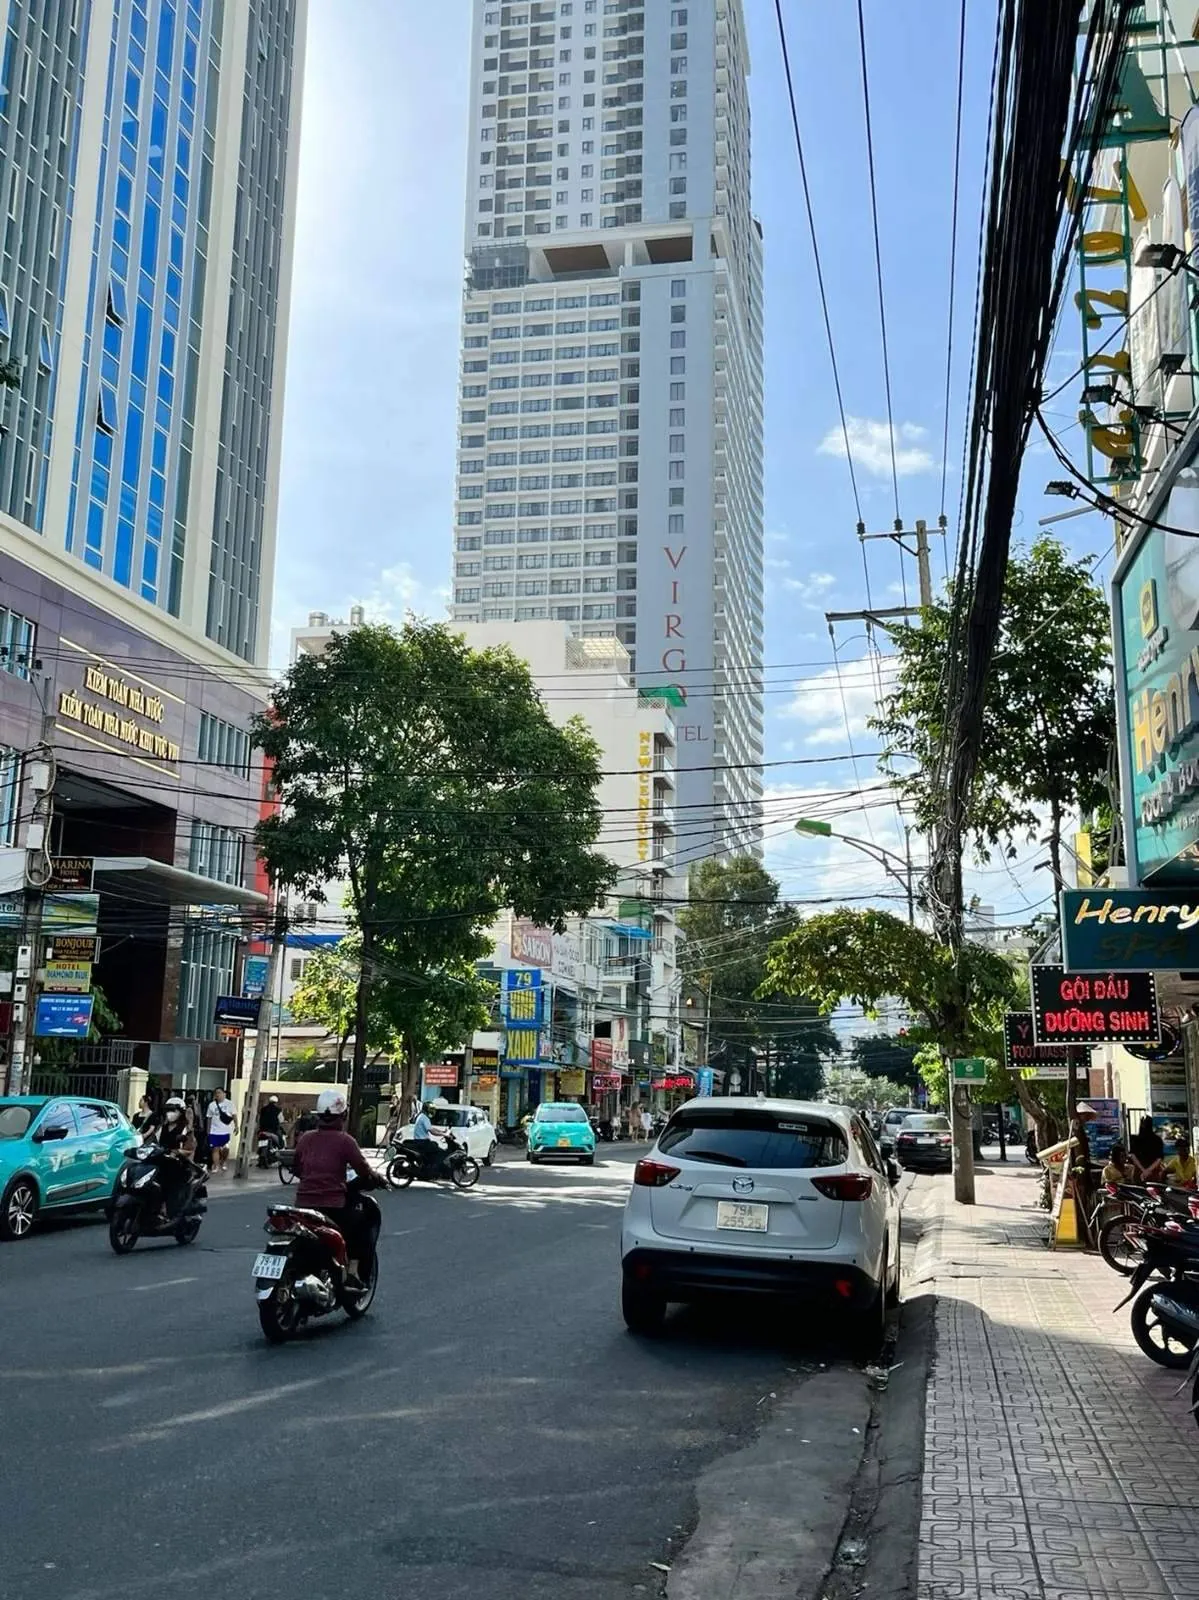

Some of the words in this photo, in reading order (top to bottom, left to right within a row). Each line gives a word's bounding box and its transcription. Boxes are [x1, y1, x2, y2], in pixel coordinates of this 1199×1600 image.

[85, 663, 108, 697] KIỂM
[108, 678, 129, 707] TOÁN
[128, 687, 145, 716] NHÀ
[60, 689, 82, 721] KIỂM
[83, 703, 104, 731] TOÁN
[103, 712, 120, 738] NHÀ
[139, 729, 155, 753] KHU
[51, 859, 91, 870] MARINA
[0, 902, 16, 913] tel
[1074, 898, 1199, 930] Henry
[55, 937, 95, 950] BONJOUR
[56, 962, 80, 970] HOTEL
[515, 971, 533, 987] 79
[1060, 976, 1091, 1004] GỘI
[1094, 971, 1129, 1000] ĐẦU
[1109, 1011, 1150, 1031] SINH
[506, 1030, 537, 1060] XANH
[1013, 1045, 1037, 1059] FOOT
